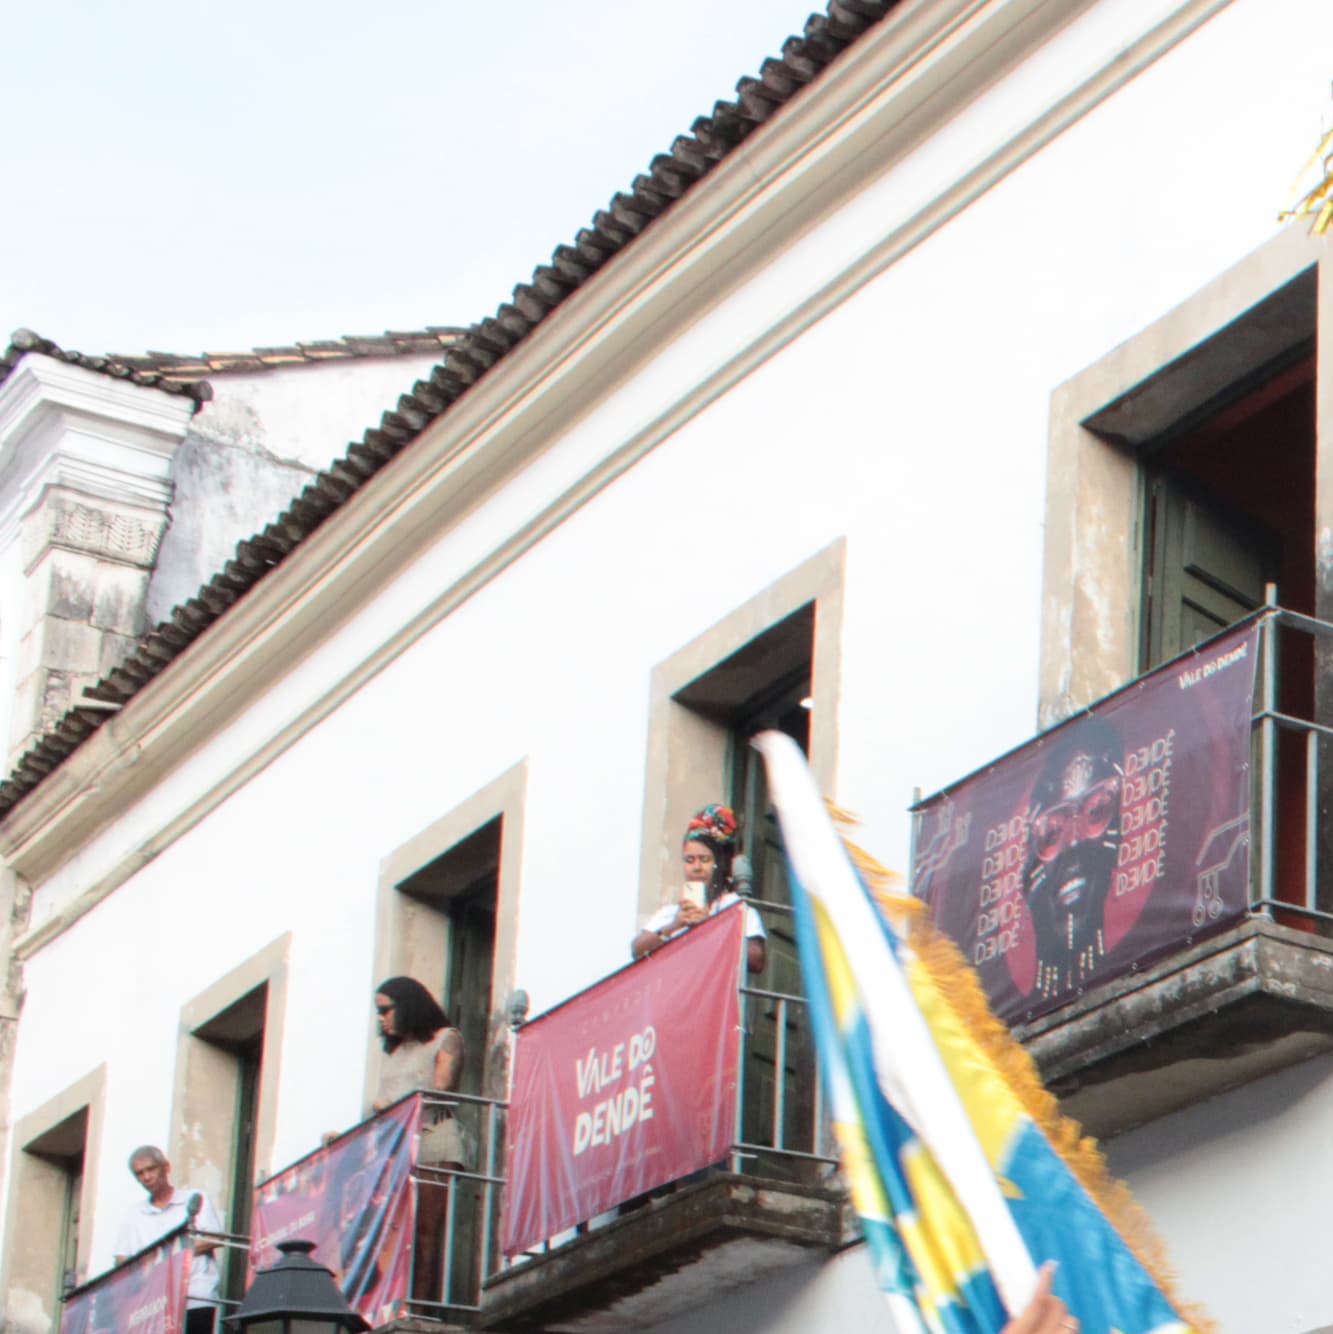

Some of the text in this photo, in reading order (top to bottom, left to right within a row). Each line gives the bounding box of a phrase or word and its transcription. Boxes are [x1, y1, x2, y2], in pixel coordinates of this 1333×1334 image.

[575, 1026, 657, 1100] VALE DO
[573, 1063, 656, 1157] DENDÊ
